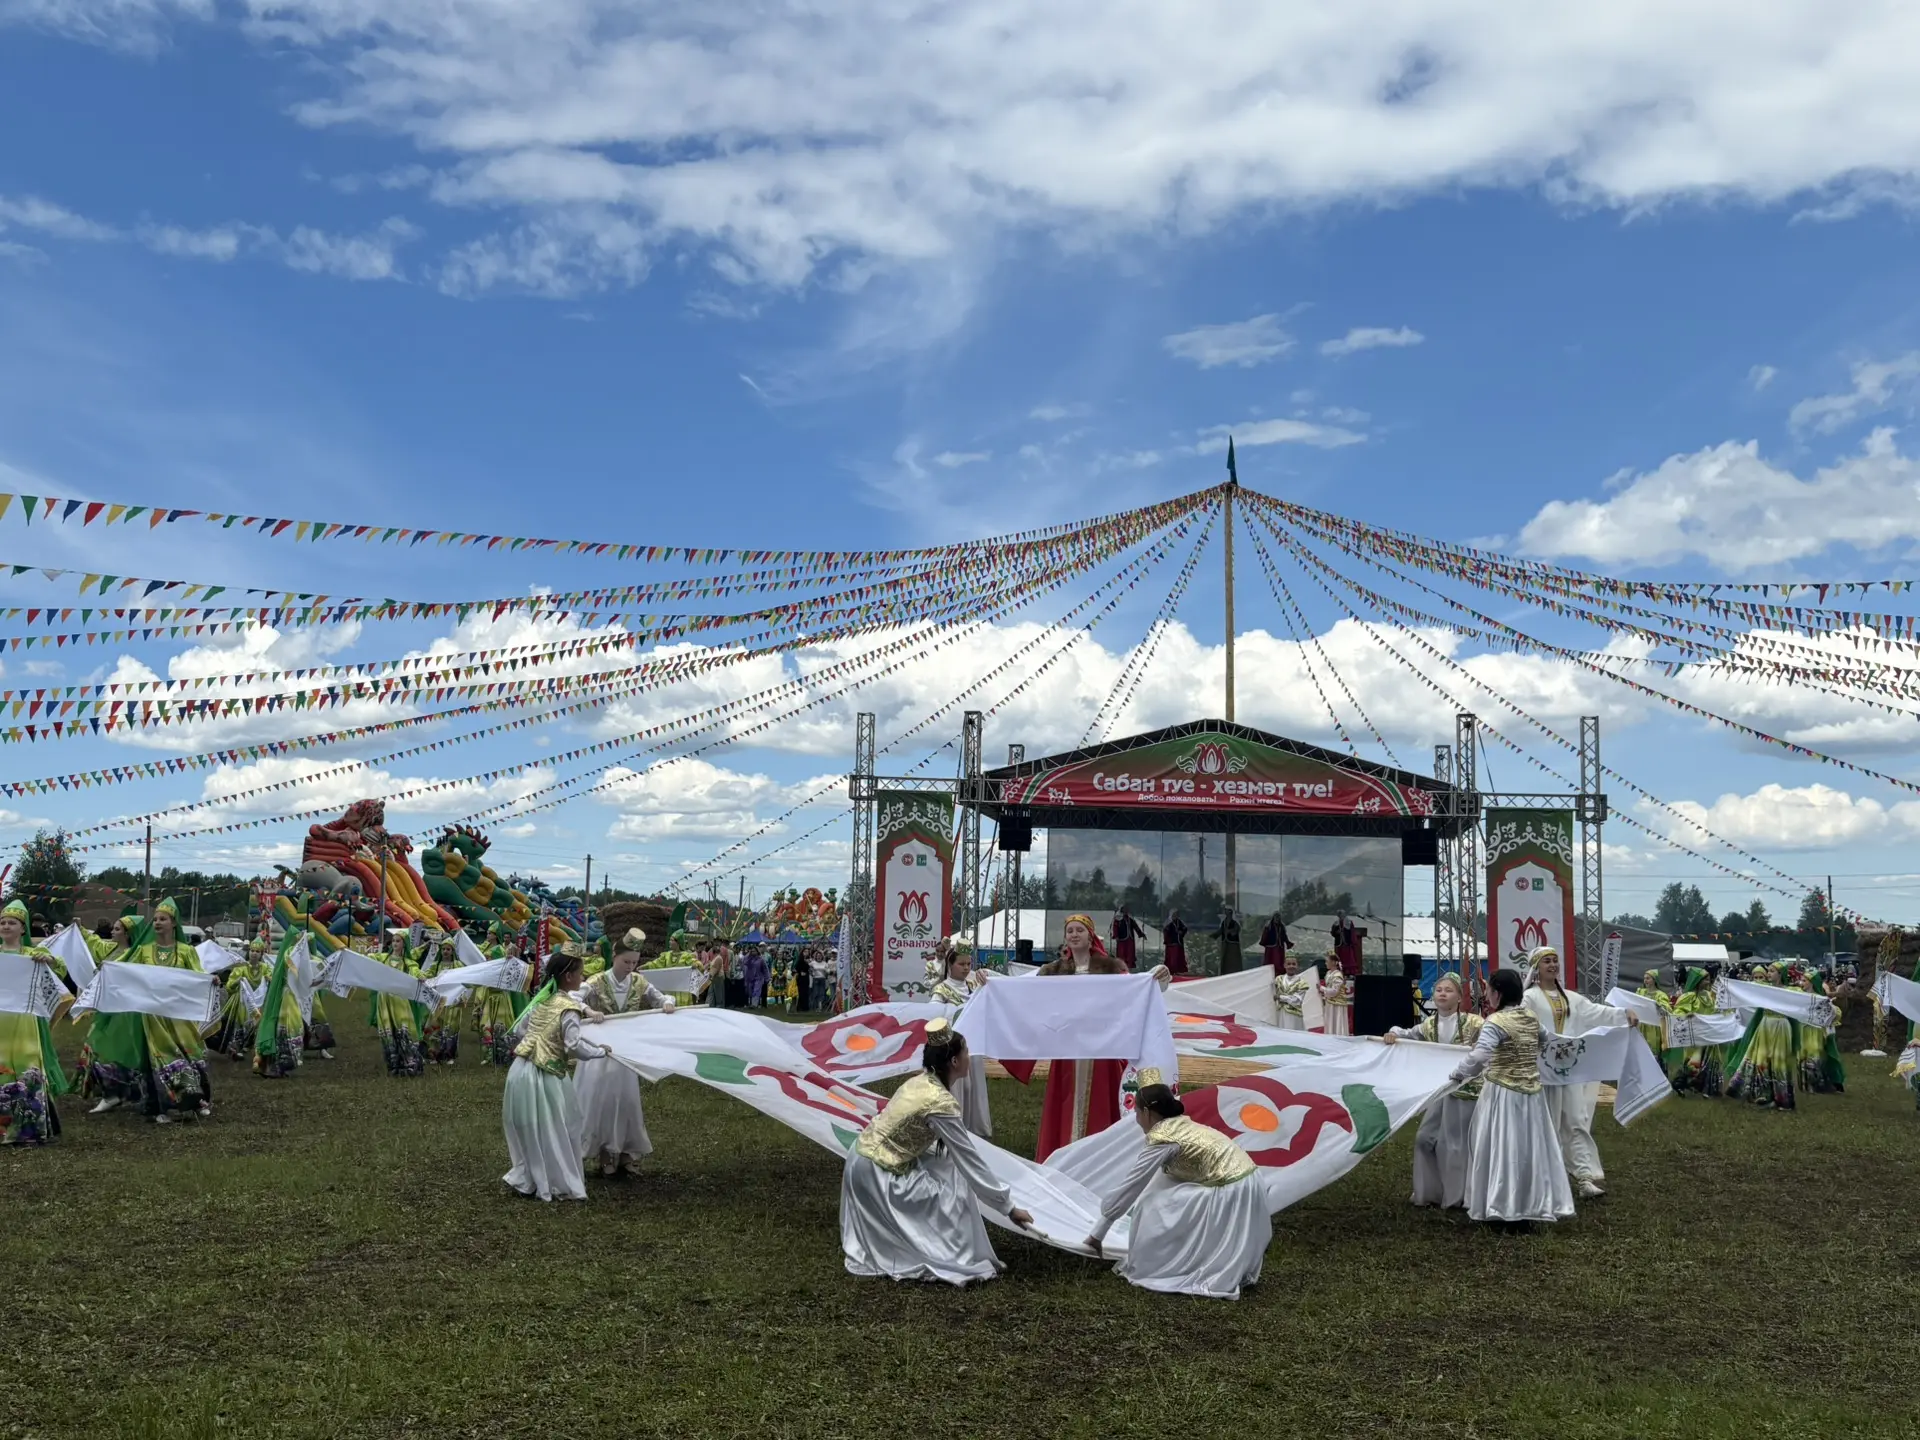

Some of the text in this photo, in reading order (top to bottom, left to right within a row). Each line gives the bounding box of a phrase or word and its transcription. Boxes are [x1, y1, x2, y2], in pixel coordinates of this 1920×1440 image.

[1093, 772, 1155, 792] Сабан
[1162, 779, 1195, 793] туе
[1212, 780, 1287, 796] хезмәт
[1292, 780, 1333, 799] туе!
[1137, 794, 1217, 803] Добро пожаловать!
